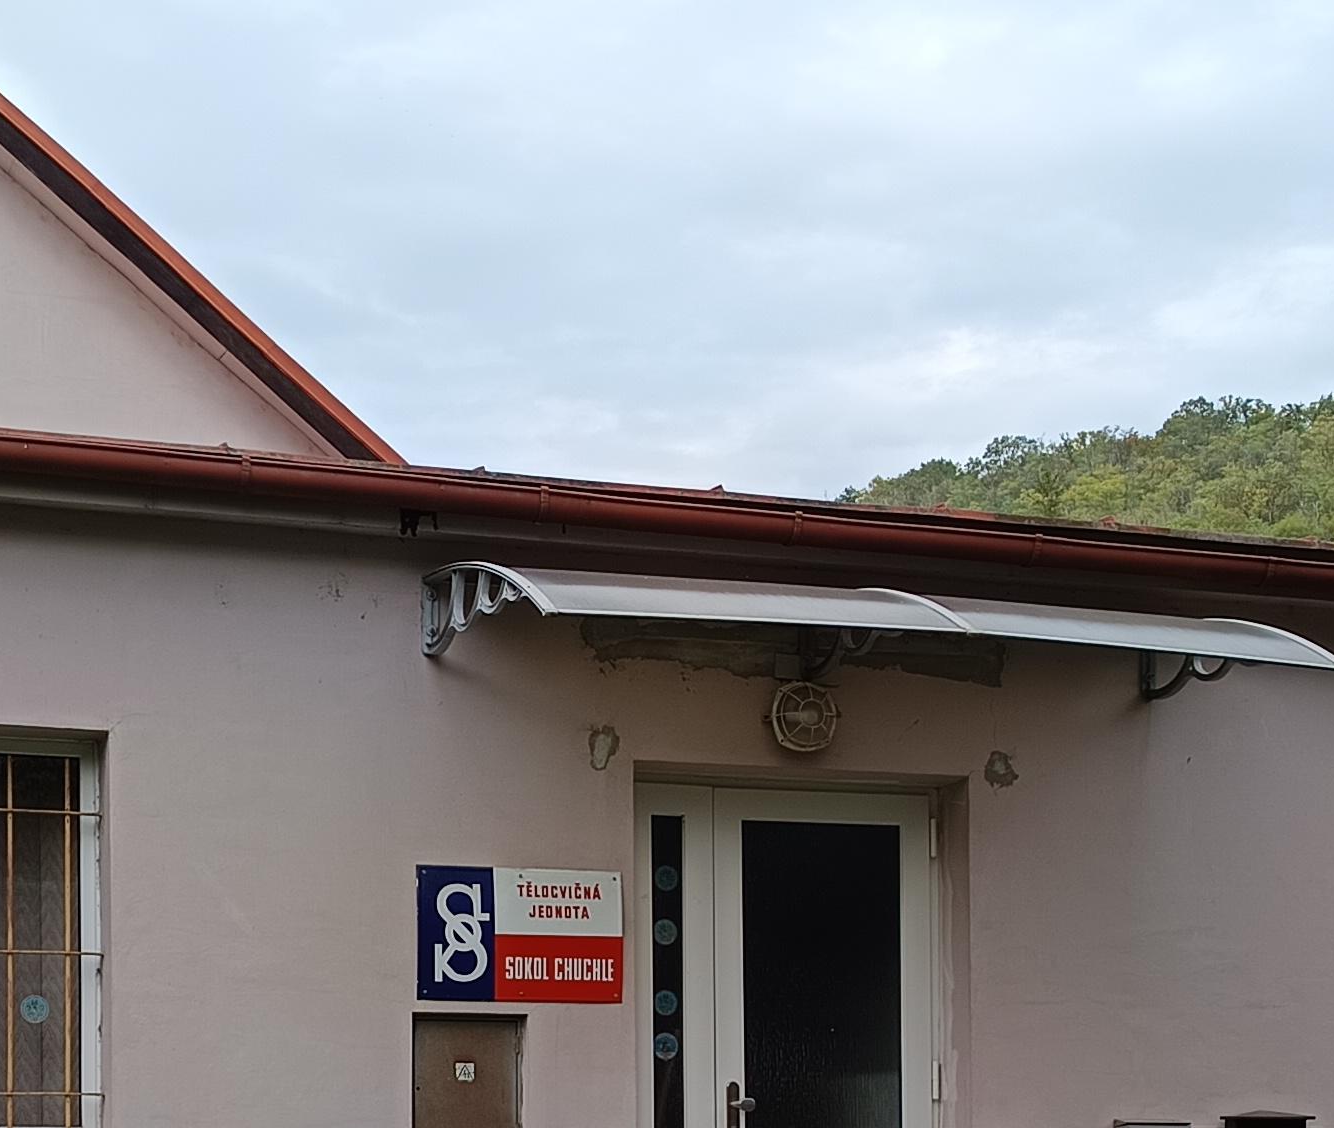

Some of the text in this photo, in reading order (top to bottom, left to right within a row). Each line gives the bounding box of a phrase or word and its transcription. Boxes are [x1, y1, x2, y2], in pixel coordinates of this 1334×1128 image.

[517, 881, 601, 900] TĚLOCVIČNÁ
[529, 905, 590, 919] JEDNOTA
[506, 957, 614, 982] SOKOL CHUCHLE
